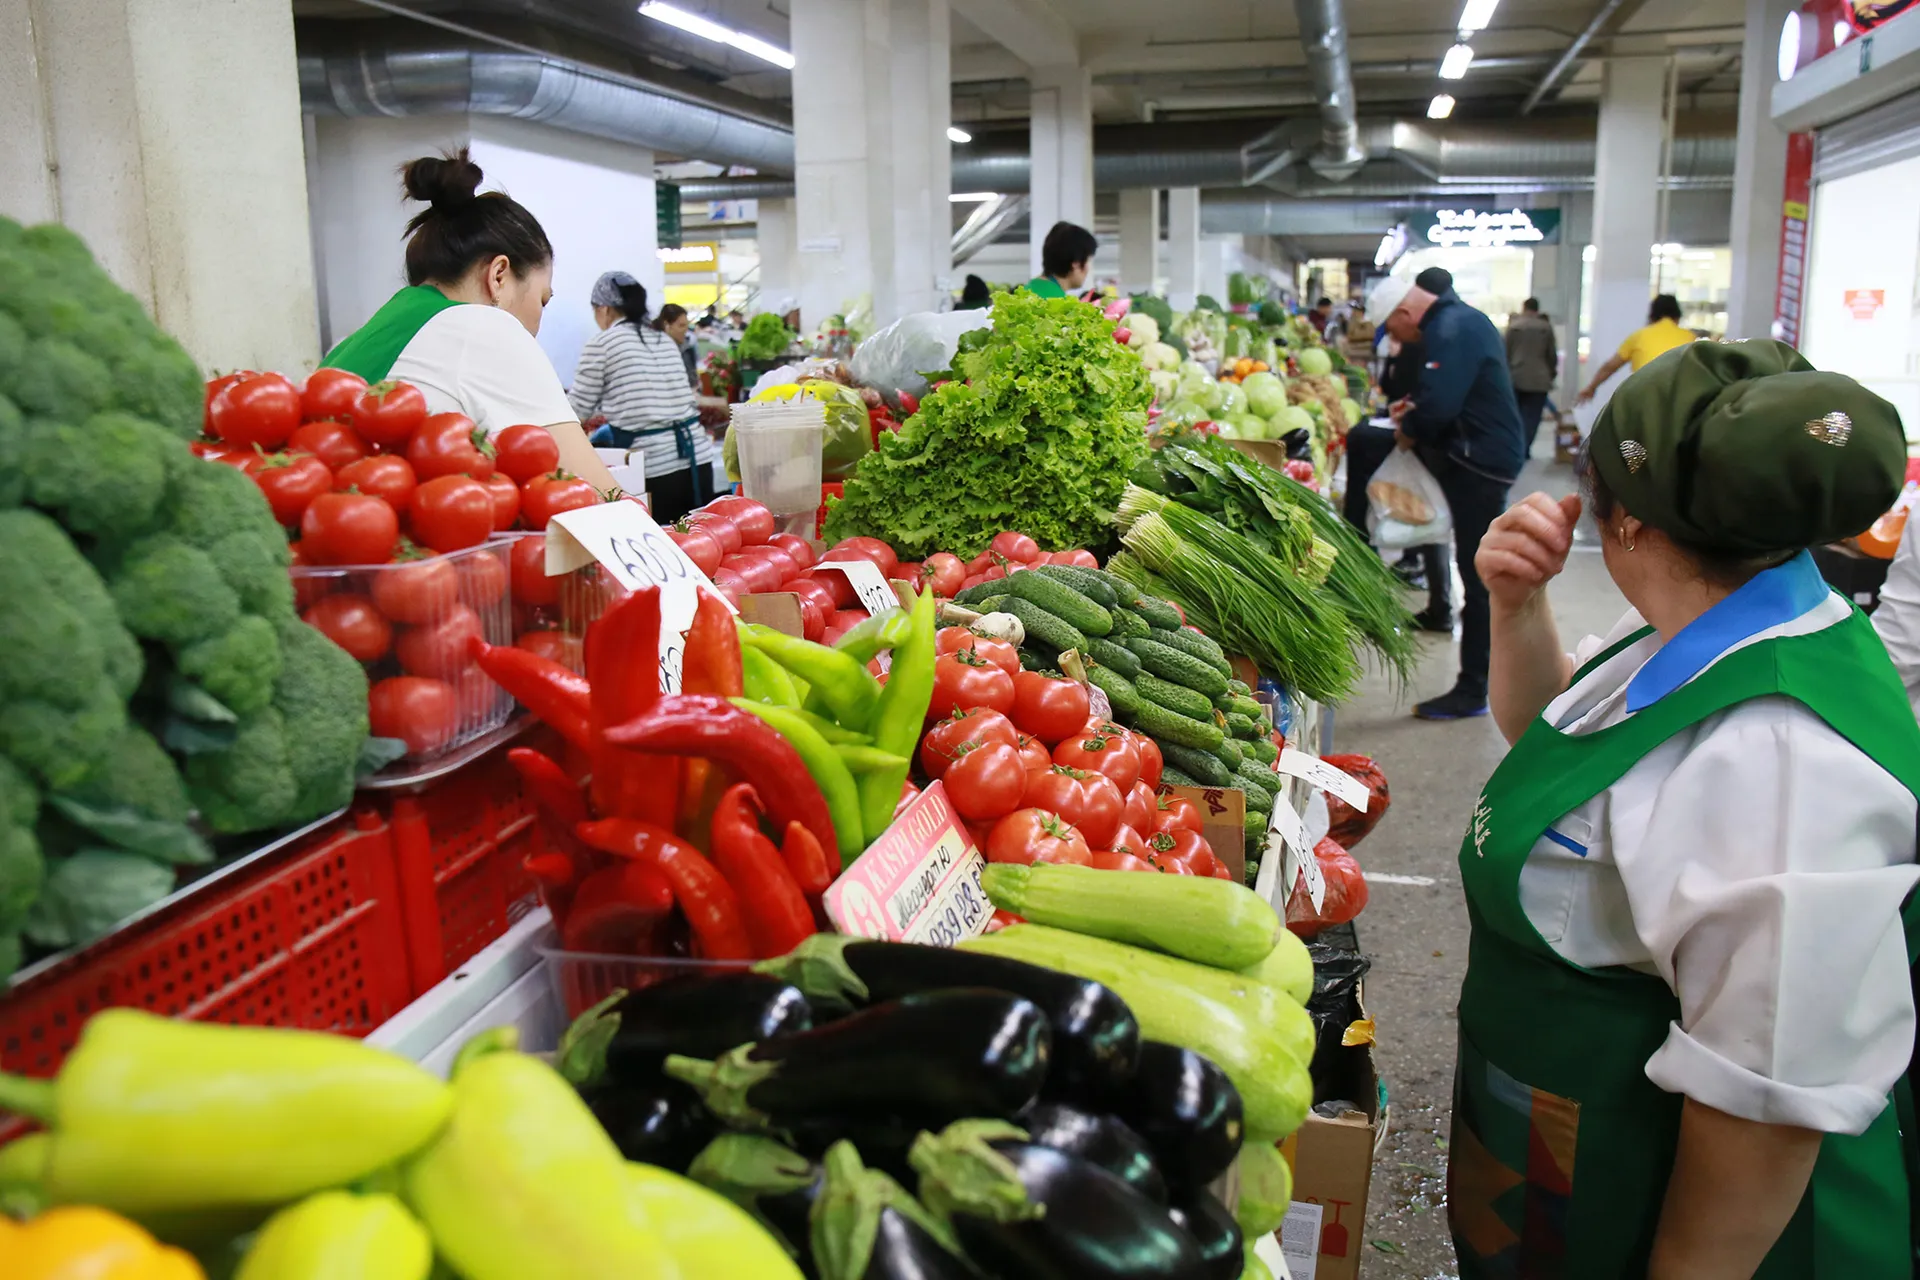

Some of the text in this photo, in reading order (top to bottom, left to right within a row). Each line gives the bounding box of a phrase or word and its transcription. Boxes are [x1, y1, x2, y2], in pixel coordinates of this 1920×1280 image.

[610, 532, 686, 586] 600
[863, 794, 948, 897] KASPI GOLD
